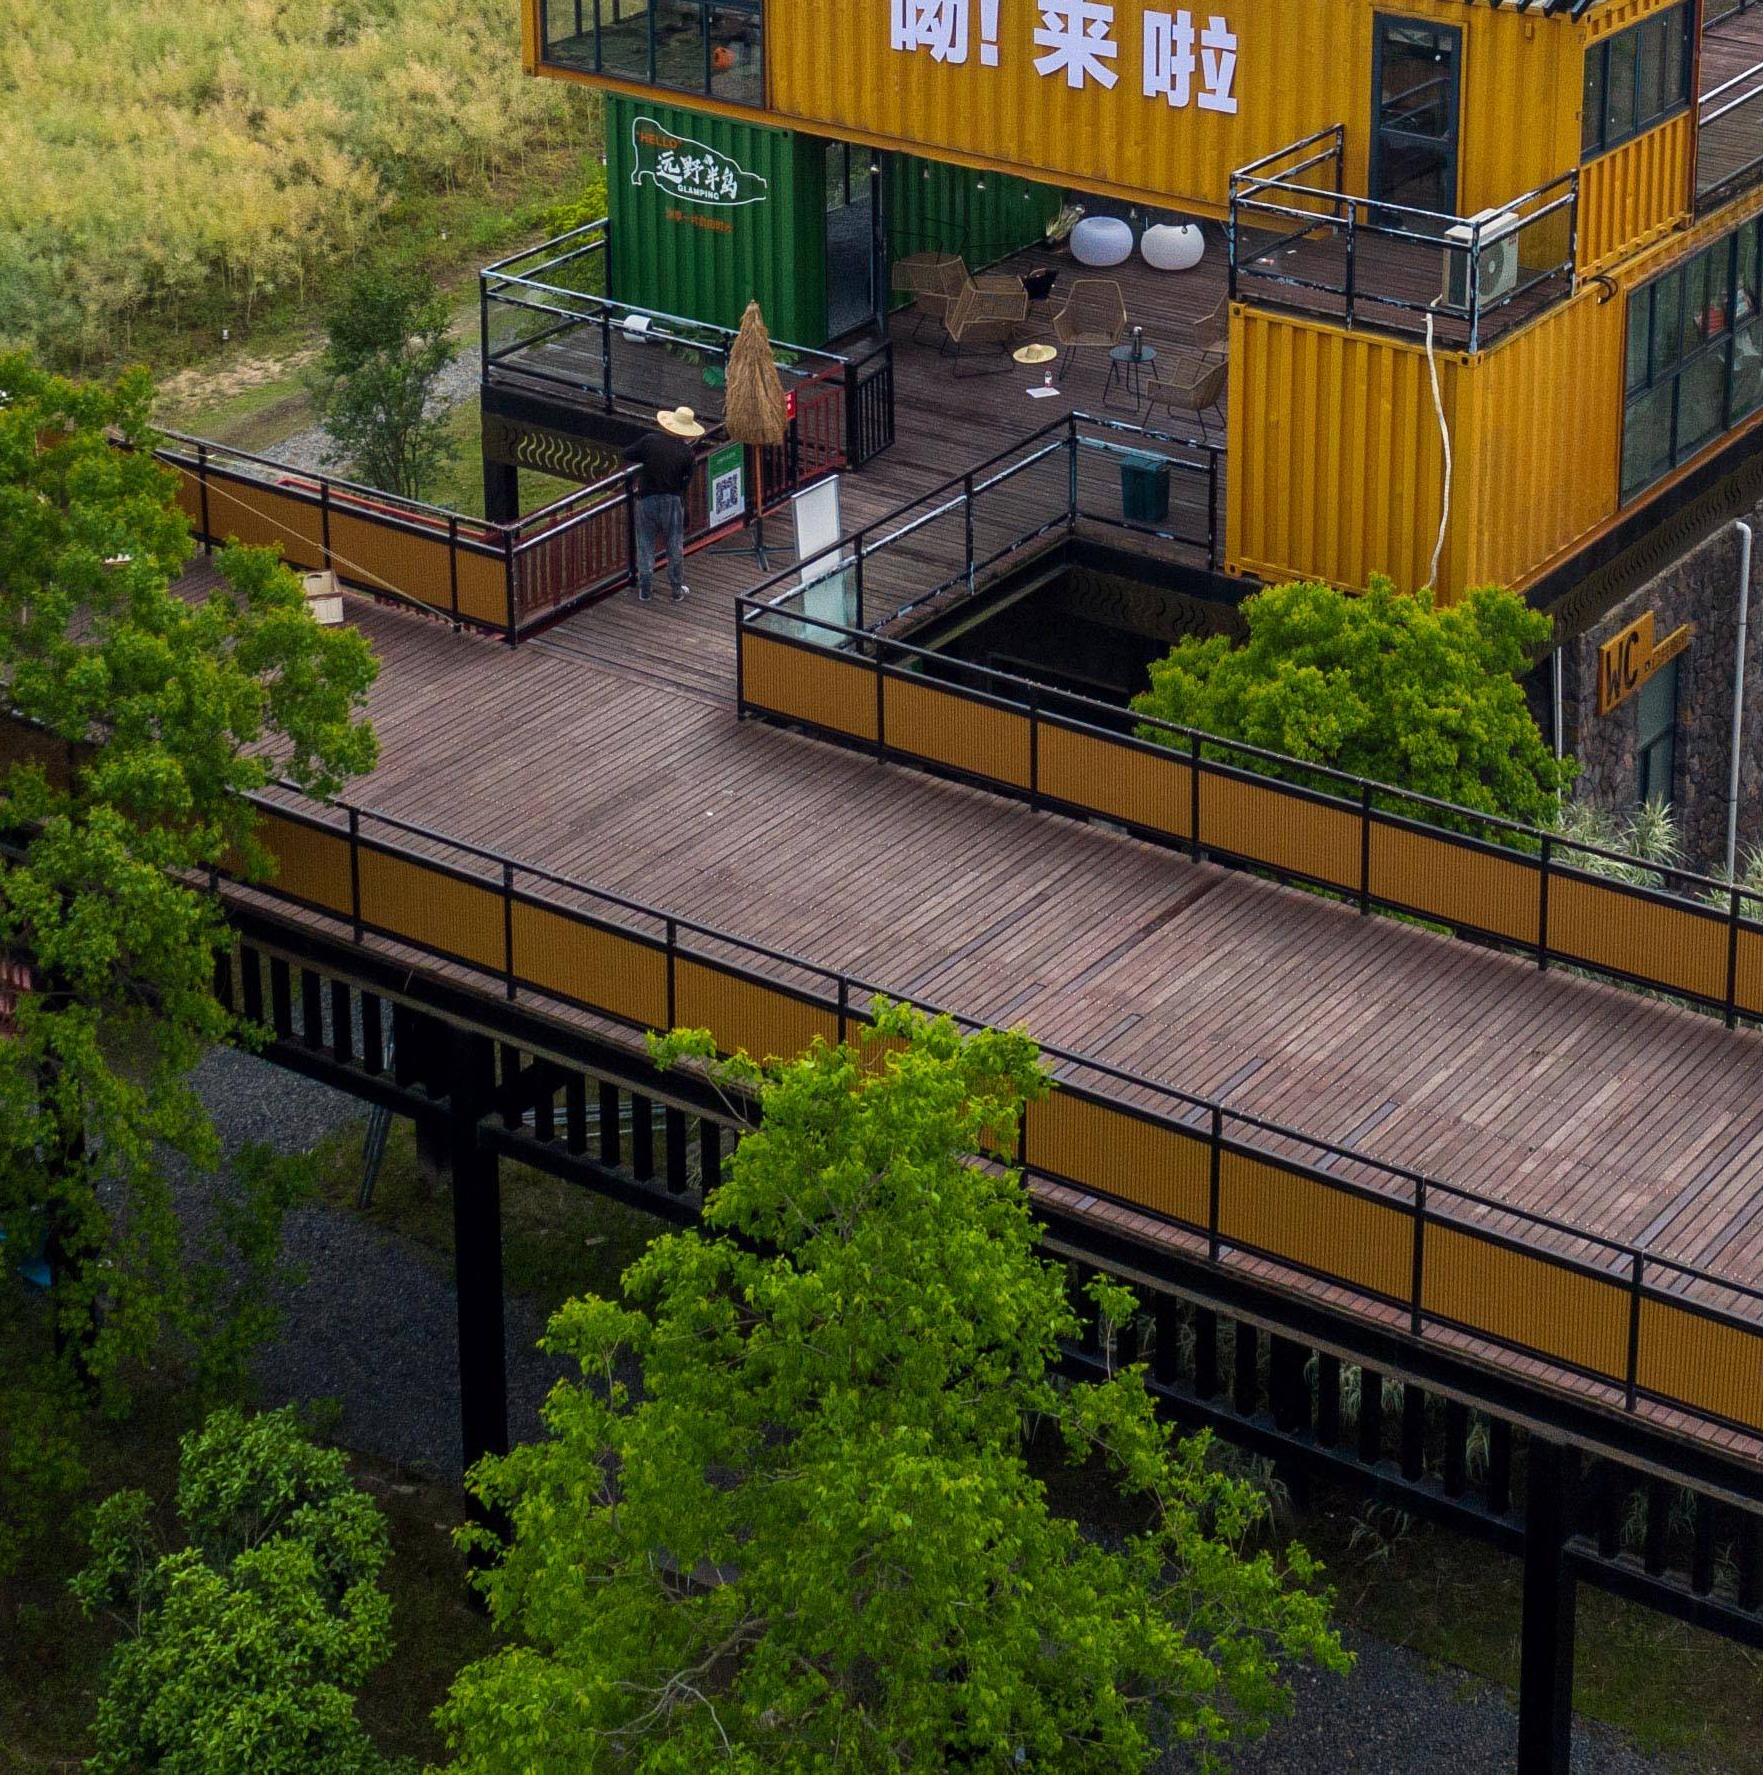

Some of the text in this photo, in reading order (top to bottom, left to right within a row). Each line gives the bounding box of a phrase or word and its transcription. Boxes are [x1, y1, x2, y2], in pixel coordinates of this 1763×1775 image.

[656, 150, 738, 200] 远野半岛
[677, 184, 720, 201] GLAMPING
[1606, 630, 1640, 708] WC
